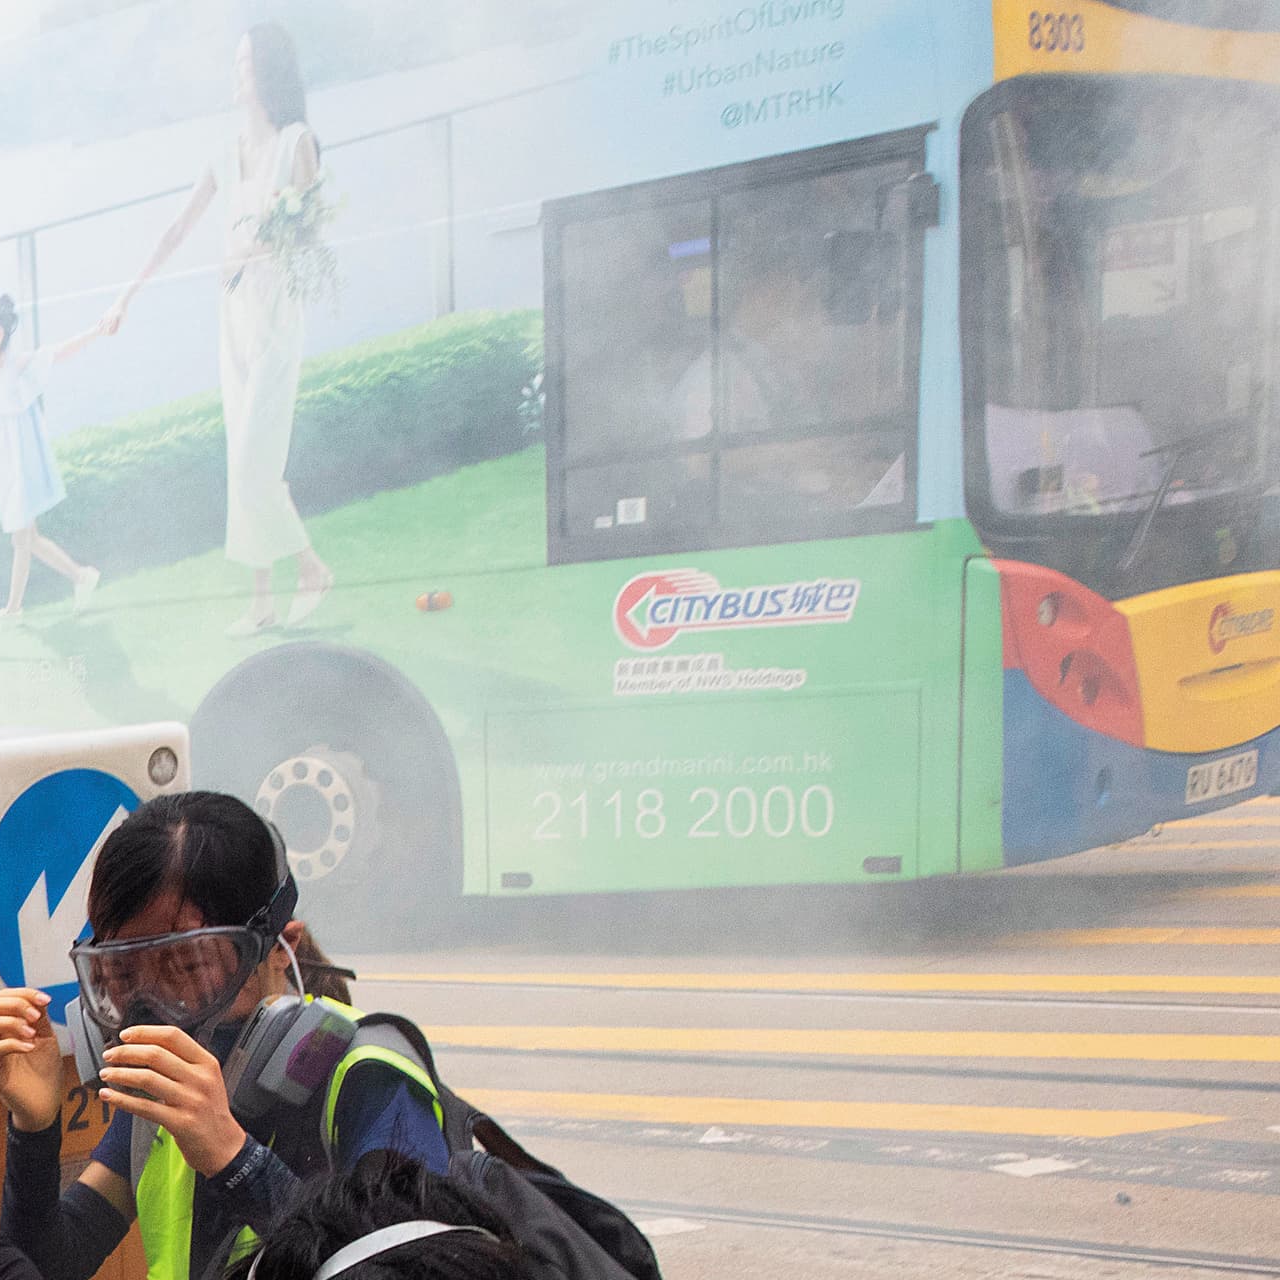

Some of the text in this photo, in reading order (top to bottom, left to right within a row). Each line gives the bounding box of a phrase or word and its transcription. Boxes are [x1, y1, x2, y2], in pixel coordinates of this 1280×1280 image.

[608, 0, 845, 65] #TheSpiritOfLiving
[1028, 11, 1085, 53] 8303
[661, 41, 845, 97] #UrbanNature
[720, 80, 846, 130] @MTRHK
[648, 580, 857, 625] CITYBUS 城巴
[616, 677, 673, 693] Member
[676, 675, 692, 690] of
[736, 669, 804, 688] Holdings
[531, 784, 835, 840] 2118 2000
